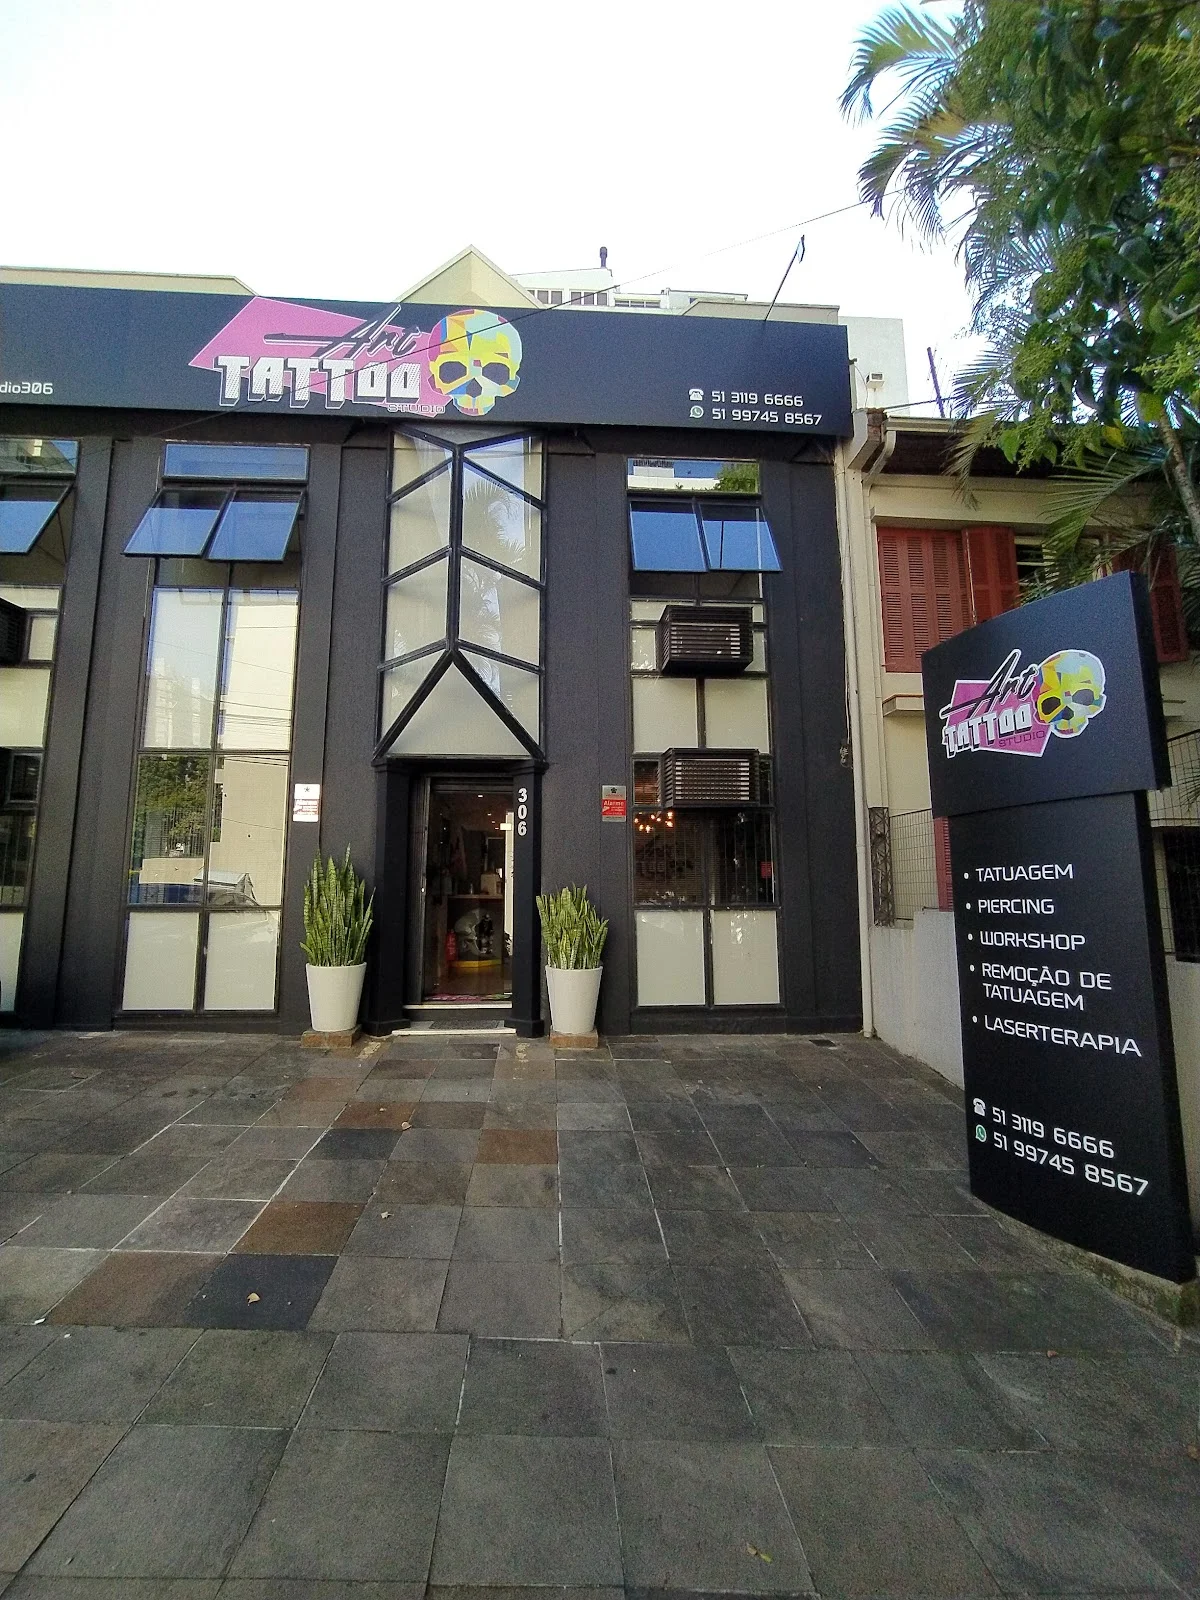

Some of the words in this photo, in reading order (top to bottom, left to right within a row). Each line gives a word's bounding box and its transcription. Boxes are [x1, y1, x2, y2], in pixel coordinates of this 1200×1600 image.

[263, 303, 422, 360] Art
[214, 355, 421, 409] TATTOO
[386, 403, 446, 414] STUDIO
[711, 390, 726, 403] 51
[730, 391, 758, 404] 3119
[764, 393, 804, 407] 6666
[712, 408, 726, 420] 51
[732, 409, 779, 423] 99745
[784, 412, 823, 426] 8567
[939, 648, 1039, 719] Art
[942, 701, 1033, 759] TATTOO
[998, 730, 1046, 748] STUDIO
[517, 787, 528, 836] 306
[975, 863, 1074, 882] TATUAGEM
[978, 898, 1055, 914] PIERCING
[979, 930, 1086, 951] WORKSHOP
[981, 962, 1070, 987] REMOÇÃO
[1079, 971, 1112, 990] DE
[982, 982, 1084, 1011] TATUAGEM
[984, 1014, 1142, 1057] LASERTERAPIA
[992, 1106, 1006, 1126] 51
[1011, 1113, 1045, 1138] 3119
[1053, 1127, 1115, 1159] 6666
[993, 1131, 1008, 1151] 51
[1013, 1140, 1075, 1175] 99745
[1084, 1163, 1149, 1196] 8567
